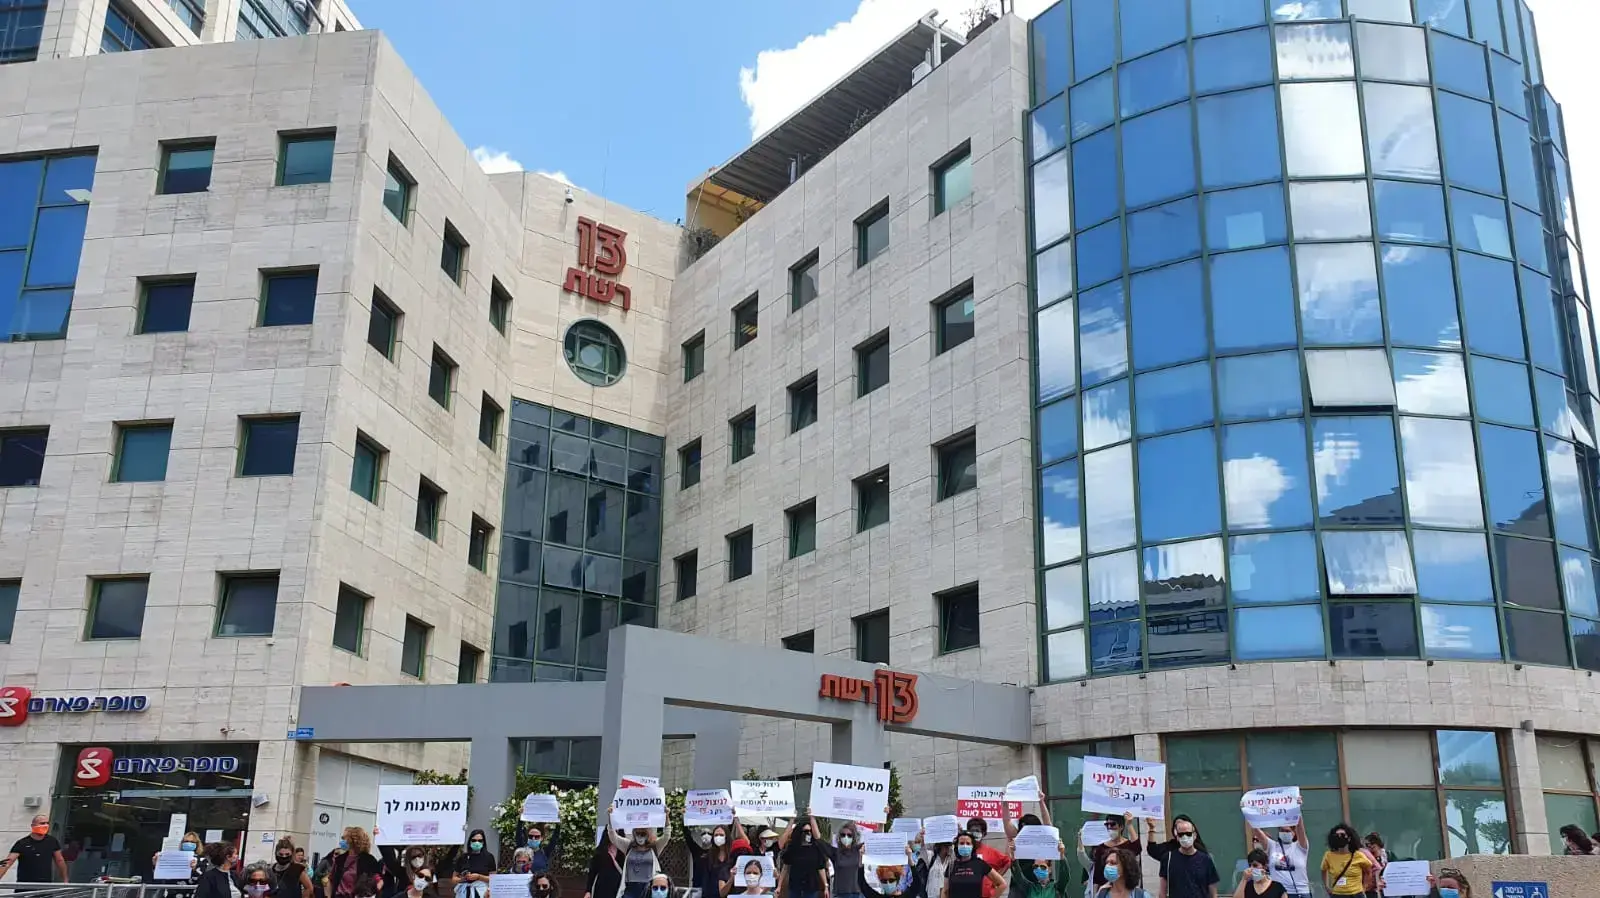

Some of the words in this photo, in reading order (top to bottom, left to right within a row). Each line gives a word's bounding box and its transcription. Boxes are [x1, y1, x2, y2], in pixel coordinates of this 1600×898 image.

[577, 215, 628, 275] 13
[563, 267, 631, 311] רשת
[818, 673, 874, 704] רשת
[875, 668, 919, 724] 13
[817, 775, 832, 789] לך
[1092, 772, 1115, 784] מיני
[1118, 773, 1156, 788] לניצול
[834, 778, 884, 793] מאמינות
[614, 798, 624, 809] לך
[626, 798, 662, 807] מאמינות
[1133, 793, 1145, 802] רק
[383, 799, 400, 815] לך
[403, 800, 461, 812] מאמינות
